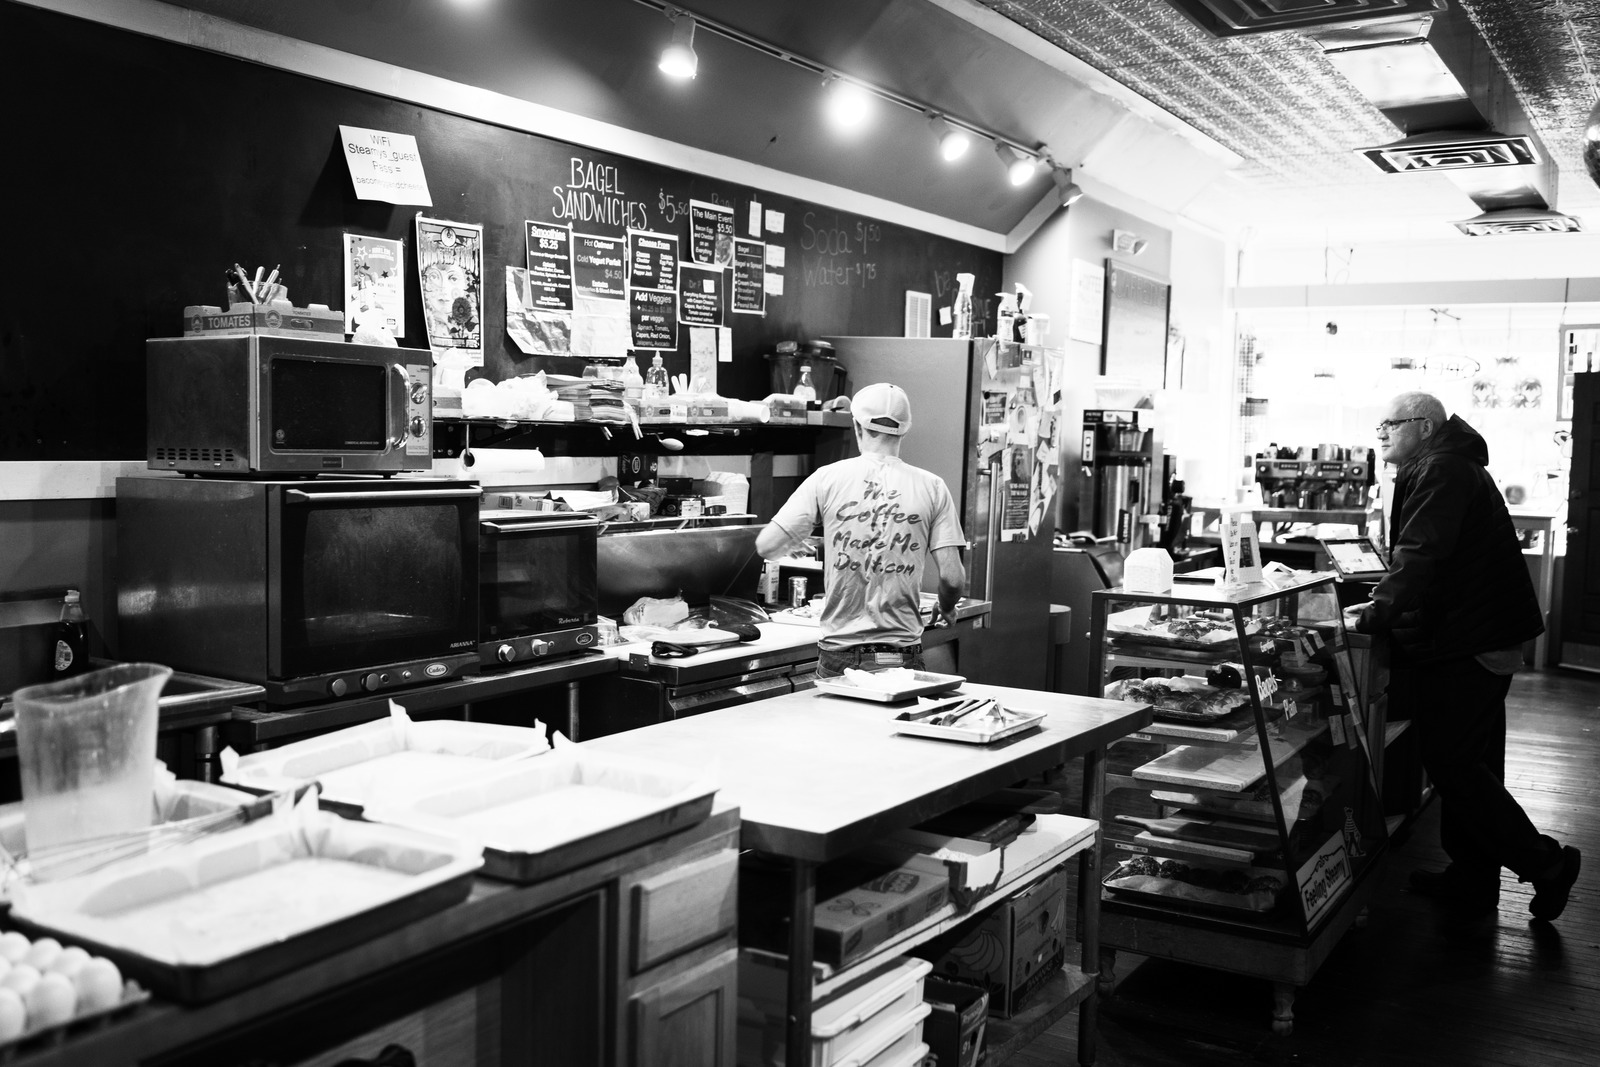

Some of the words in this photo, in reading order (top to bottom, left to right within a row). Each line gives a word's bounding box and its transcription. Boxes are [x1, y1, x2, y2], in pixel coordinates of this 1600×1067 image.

[370, 134, 391, 147] WiFi
[348, 143, 417, 162] Steamys_guest
[372, 160, 393, 173] Pass
[566, 157, 625, 195] BAGEL
[552, 186, 648, 230] SANDWICHES
[658, 188, 690, 223] $5.50
[692, 208, 703, 219] The
[704, 210, 717, 221] Main
[717, 213, 733, 224] Event
[531, 226, 566, 241] Smoothies
[717, 223, 733, 234] $5.50
[801, 211, 852, 256] Soda
[539, 238, 559, 250] $5.25
[584, 239, 593, 247] Hot
[593, 240, 614, 250] Oatmeal
[738, 245, 749, 254] Bagel
[695, 246, 712, 256] Everything
[577, 254, 589, 263] Cold
[604, 268, 622, 280] $4.50
[802, 255, 853, 287] Water
[635, 291, 648, 302] Add
[648, 292, 672, 305] Veggies
[208, 314, 251, 328] TOMATES
[641, 314, 649, 323] per
[649, 315, 664, 324] veggie
[637, 323, 654, 332] Spinach,
[654, 324, 670, 333] Tomato,
[635, 331, 650, 339] Capers,
[836, 501, 922, 532] Coffee
[833, 530, 887, 552] Made
[890, 532, 920, 554] Me
[450, 641, 473, 649] ARIANNA
[428, 666, 445, 674] Cadco
[1304, 878, 1328, 912] Feeling
[1324, 858, 1346, 890] Steamy
